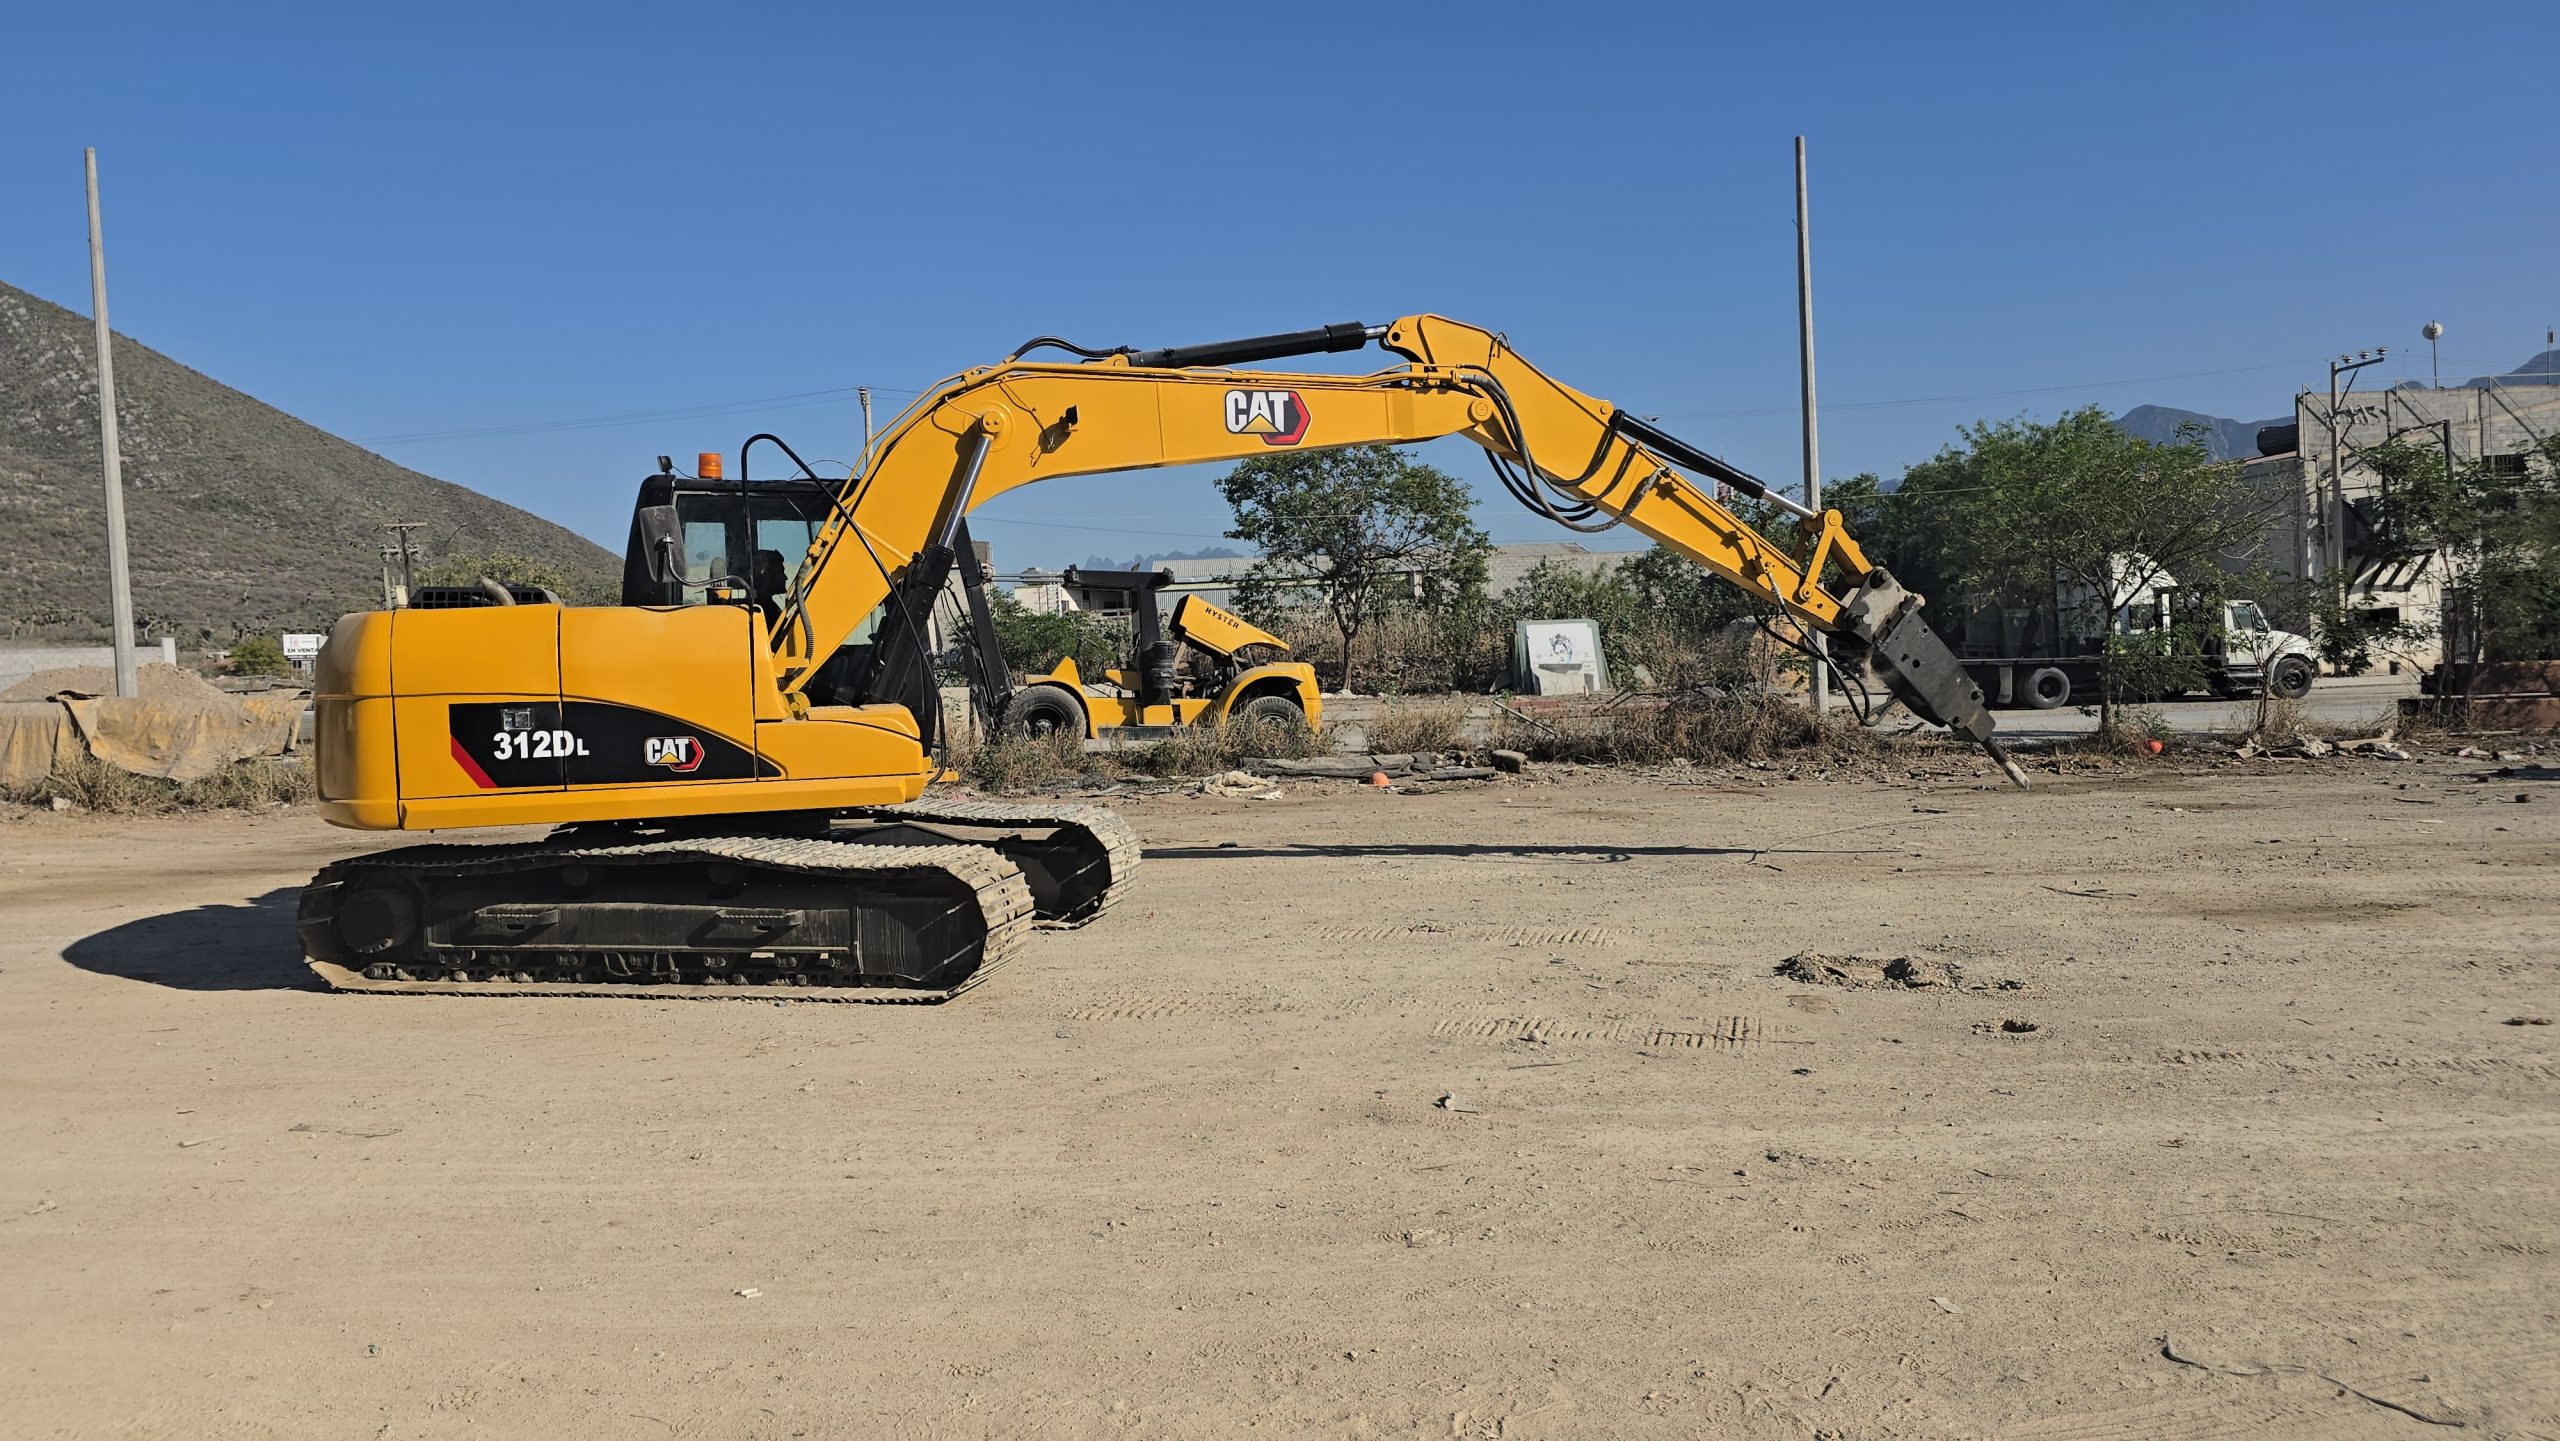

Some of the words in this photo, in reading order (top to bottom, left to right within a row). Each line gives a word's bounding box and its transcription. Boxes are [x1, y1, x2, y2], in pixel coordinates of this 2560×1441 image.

[1226, 391, 1289, 433] CAT
[1205, 606, 1239, 629] HYSTER
[646, 738, 690, 764] CAT
